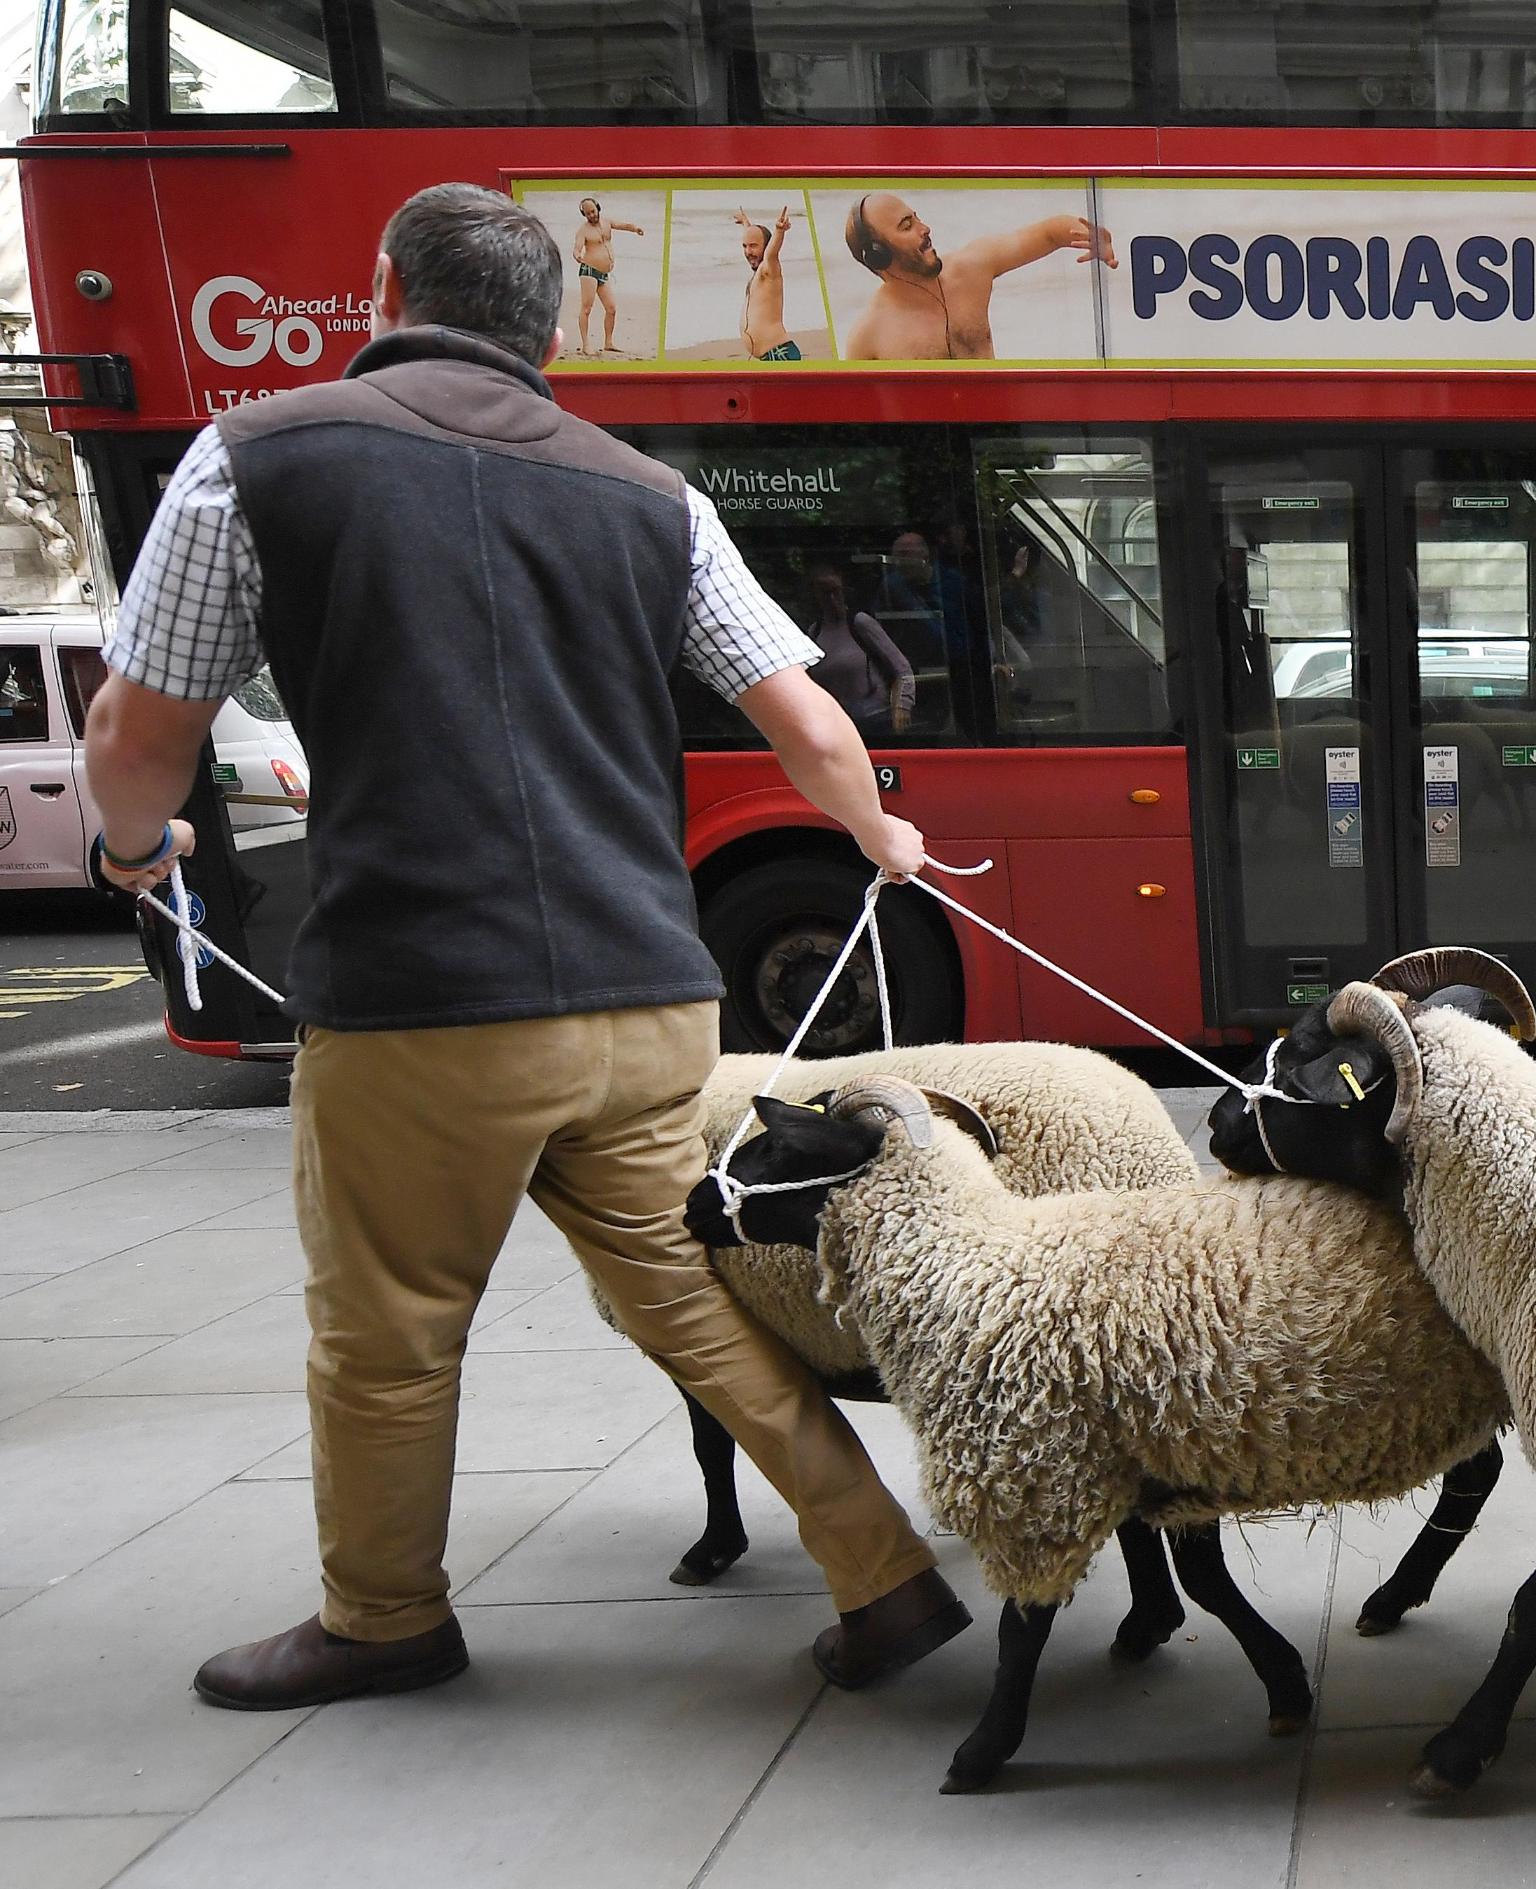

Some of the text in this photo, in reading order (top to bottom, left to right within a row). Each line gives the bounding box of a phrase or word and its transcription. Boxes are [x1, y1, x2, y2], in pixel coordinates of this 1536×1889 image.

[260, 292, 373, 315] Ahead-Lo
[191, 275, 323, 367] Go
[326, 318, 371, 332] LONDO
[699, 467, 841, 493] Whitehall
[717, 497, 824, 510] HORSE GUARDS
[1328, 751, 1355, 759] oyster
[1427, 749, 1454, 758] oyster
